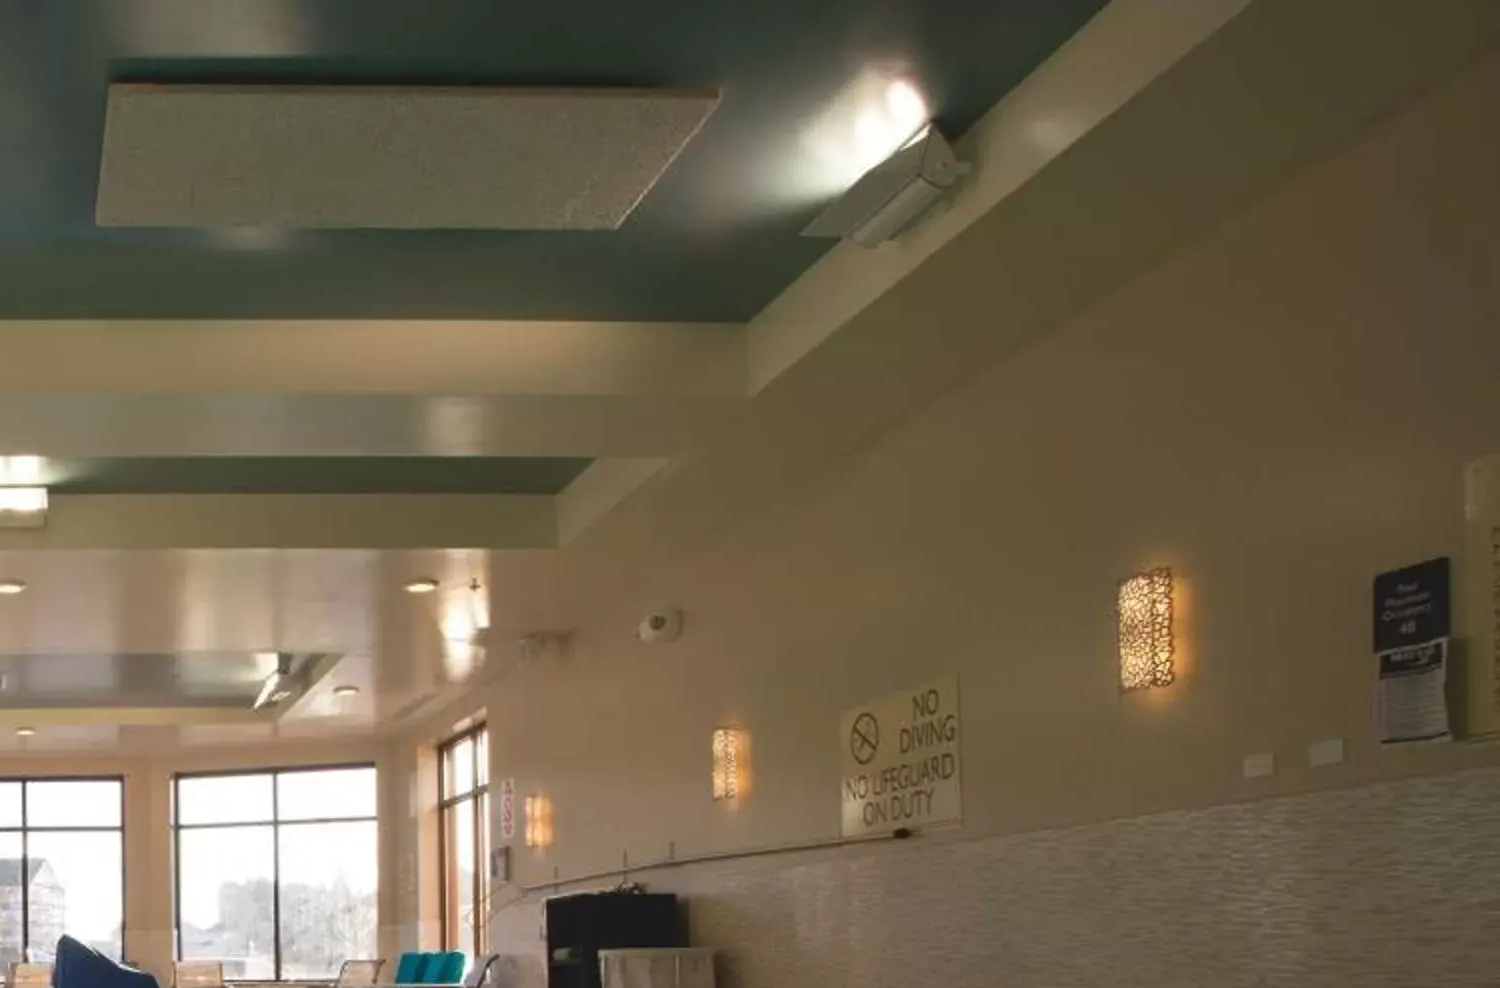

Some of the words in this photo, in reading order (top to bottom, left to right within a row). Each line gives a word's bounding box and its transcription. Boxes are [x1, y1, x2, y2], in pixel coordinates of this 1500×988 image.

[912, 688, 940, 721] NO
[899, 714, 956, 754] DIVING
[846, 775, 869, 801] NO
[873, 753, 955, 796] LIFEGUARD
[863, 802, 888, 827] ON
[891, 788, 934, 821] DUTY
